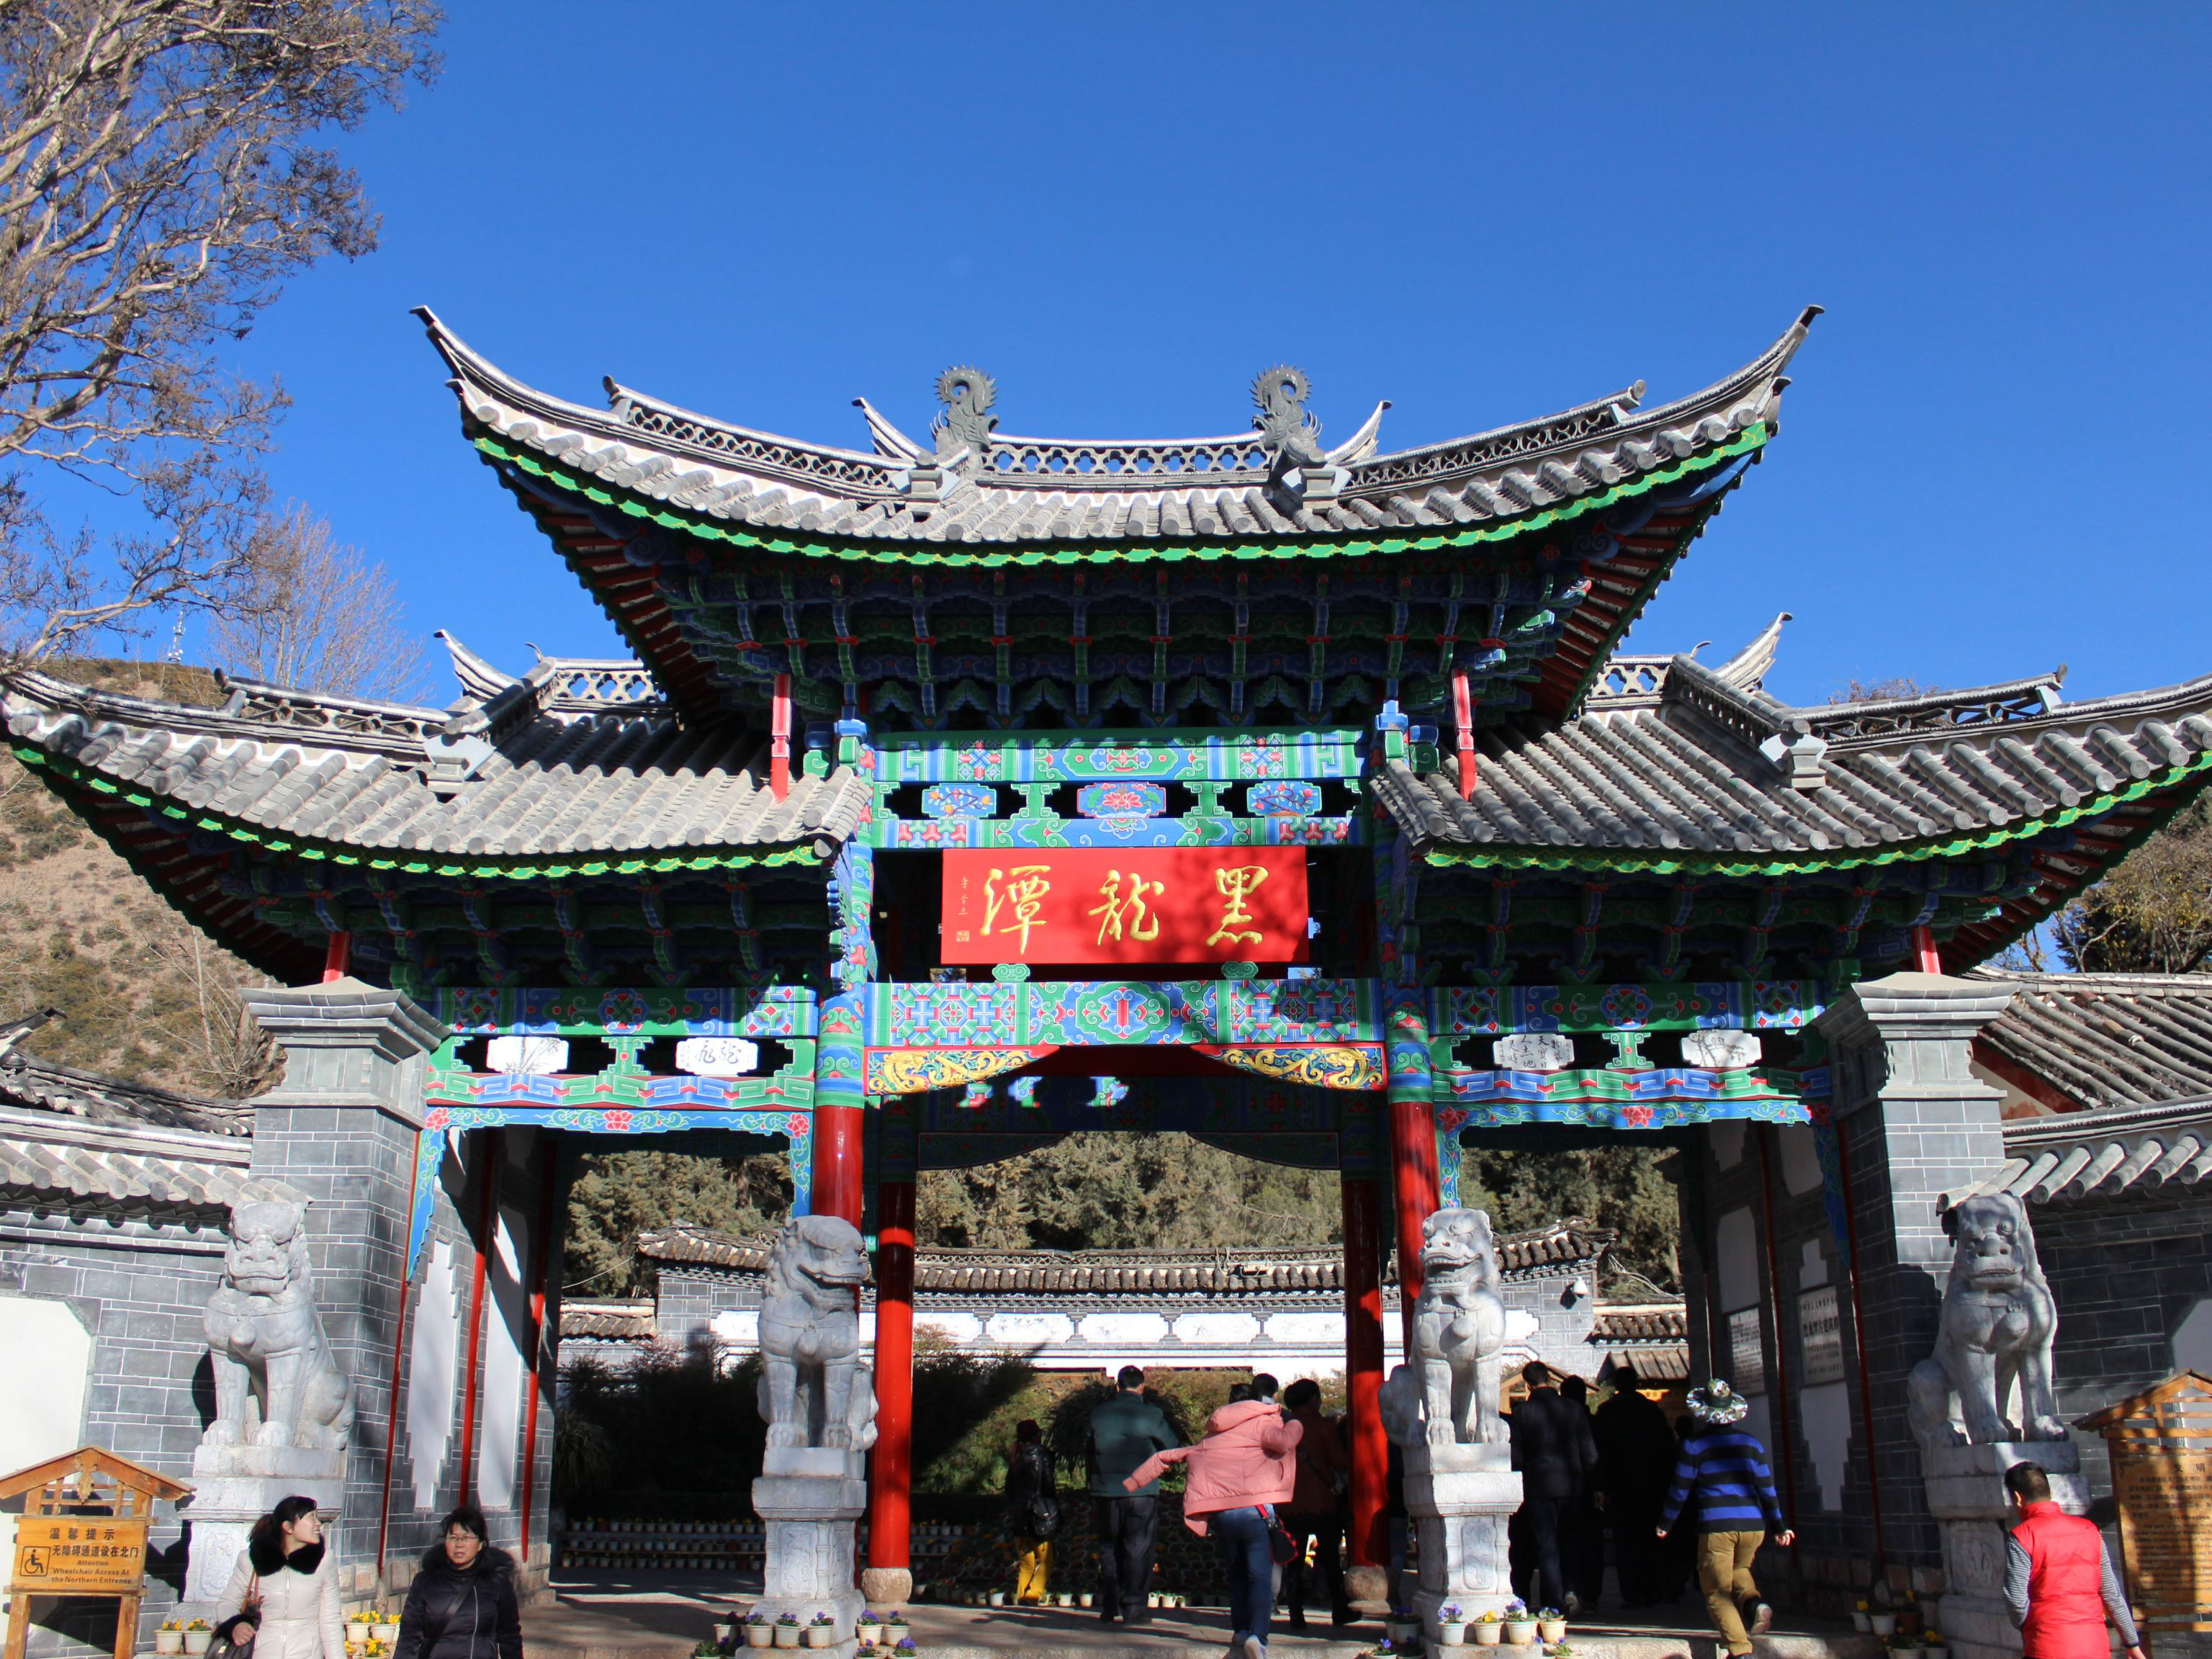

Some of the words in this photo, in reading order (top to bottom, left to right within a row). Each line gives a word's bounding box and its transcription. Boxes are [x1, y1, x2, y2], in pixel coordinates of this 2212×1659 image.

[50, 1527, 115, 1540] 温馨提示
[52, 1545, 139, 1558] 无障碍通道设在北门
